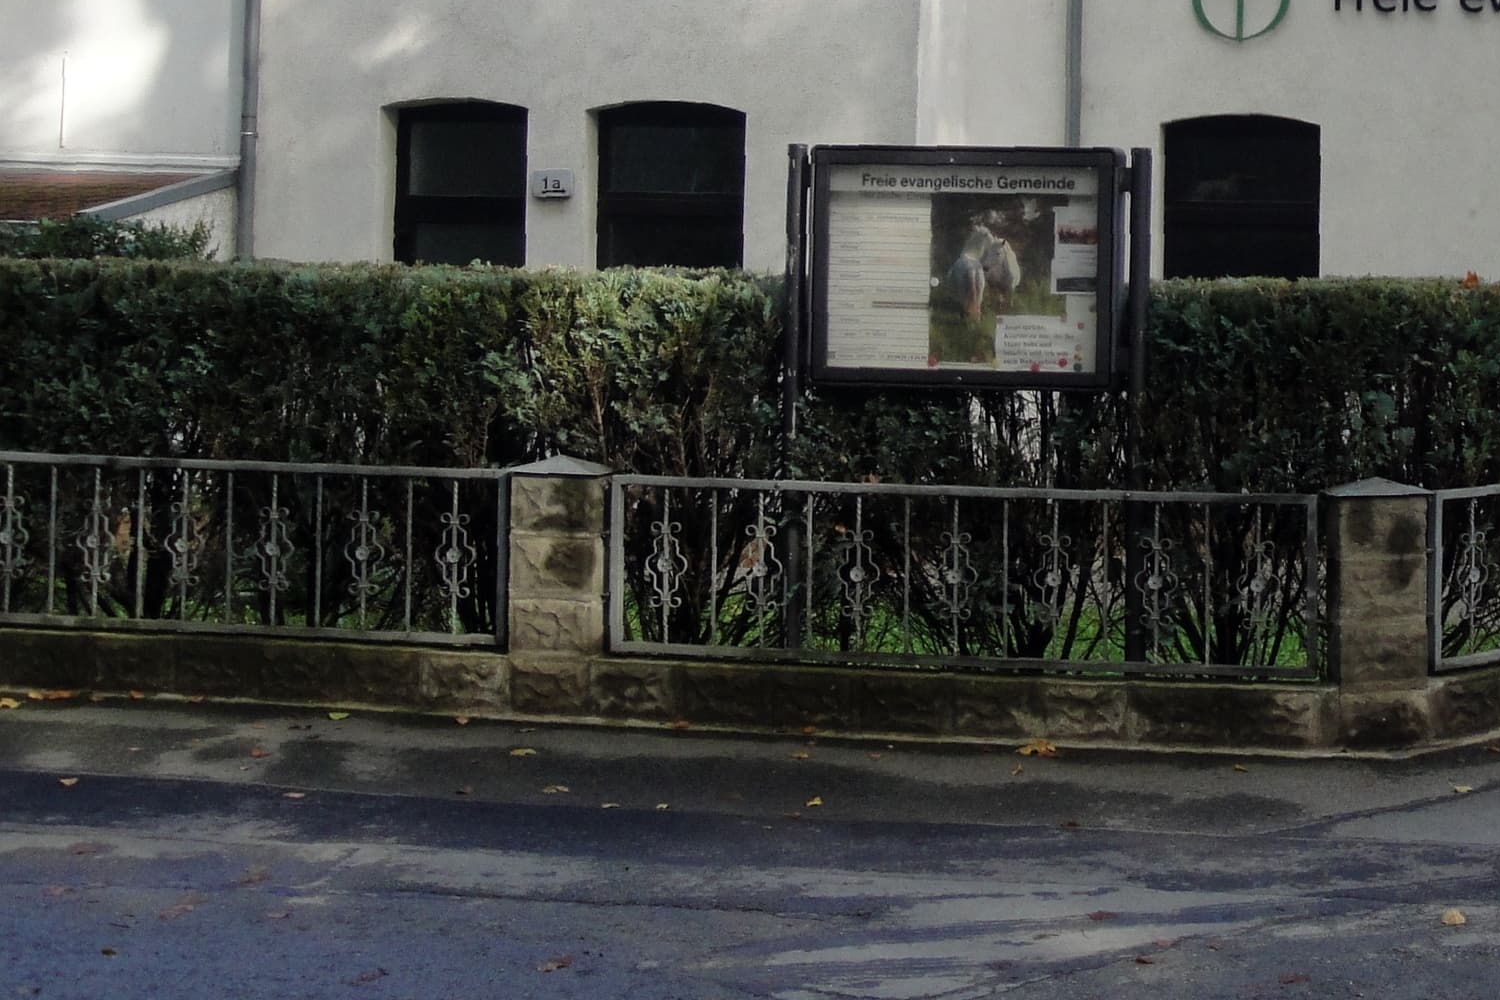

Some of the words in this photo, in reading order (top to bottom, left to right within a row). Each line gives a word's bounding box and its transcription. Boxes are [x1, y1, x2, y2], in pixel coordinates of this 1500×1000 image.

[541, 176, 561, 190] 1a
[862, 173, 897, 187] Freie
[900, 174, 993, 191] evangelische
[997, 175, 1076, 190] Gemeinde
